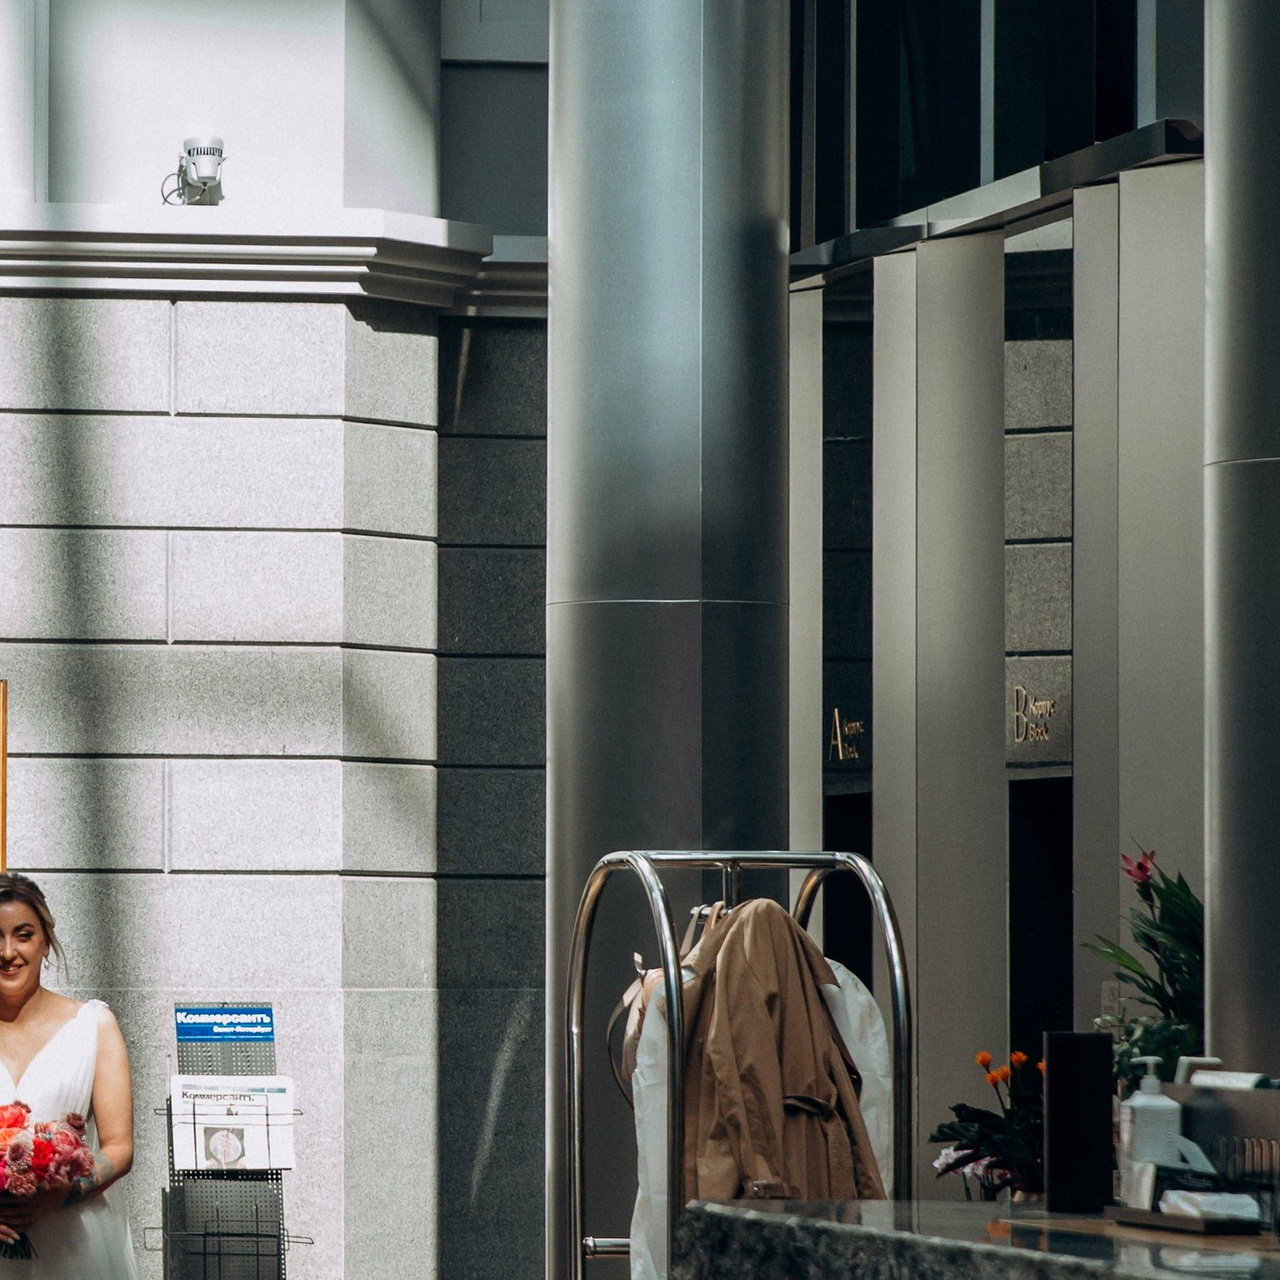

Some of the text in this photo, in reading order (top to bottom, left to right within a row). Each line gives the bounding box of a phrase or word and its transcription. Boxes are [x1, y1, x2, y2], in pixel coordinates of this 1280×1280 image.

[829, 707, 843, 760] A
[1030, 721, 1049, 741] Block
[176, 1011, 272, 1026] Коммерсантъ
